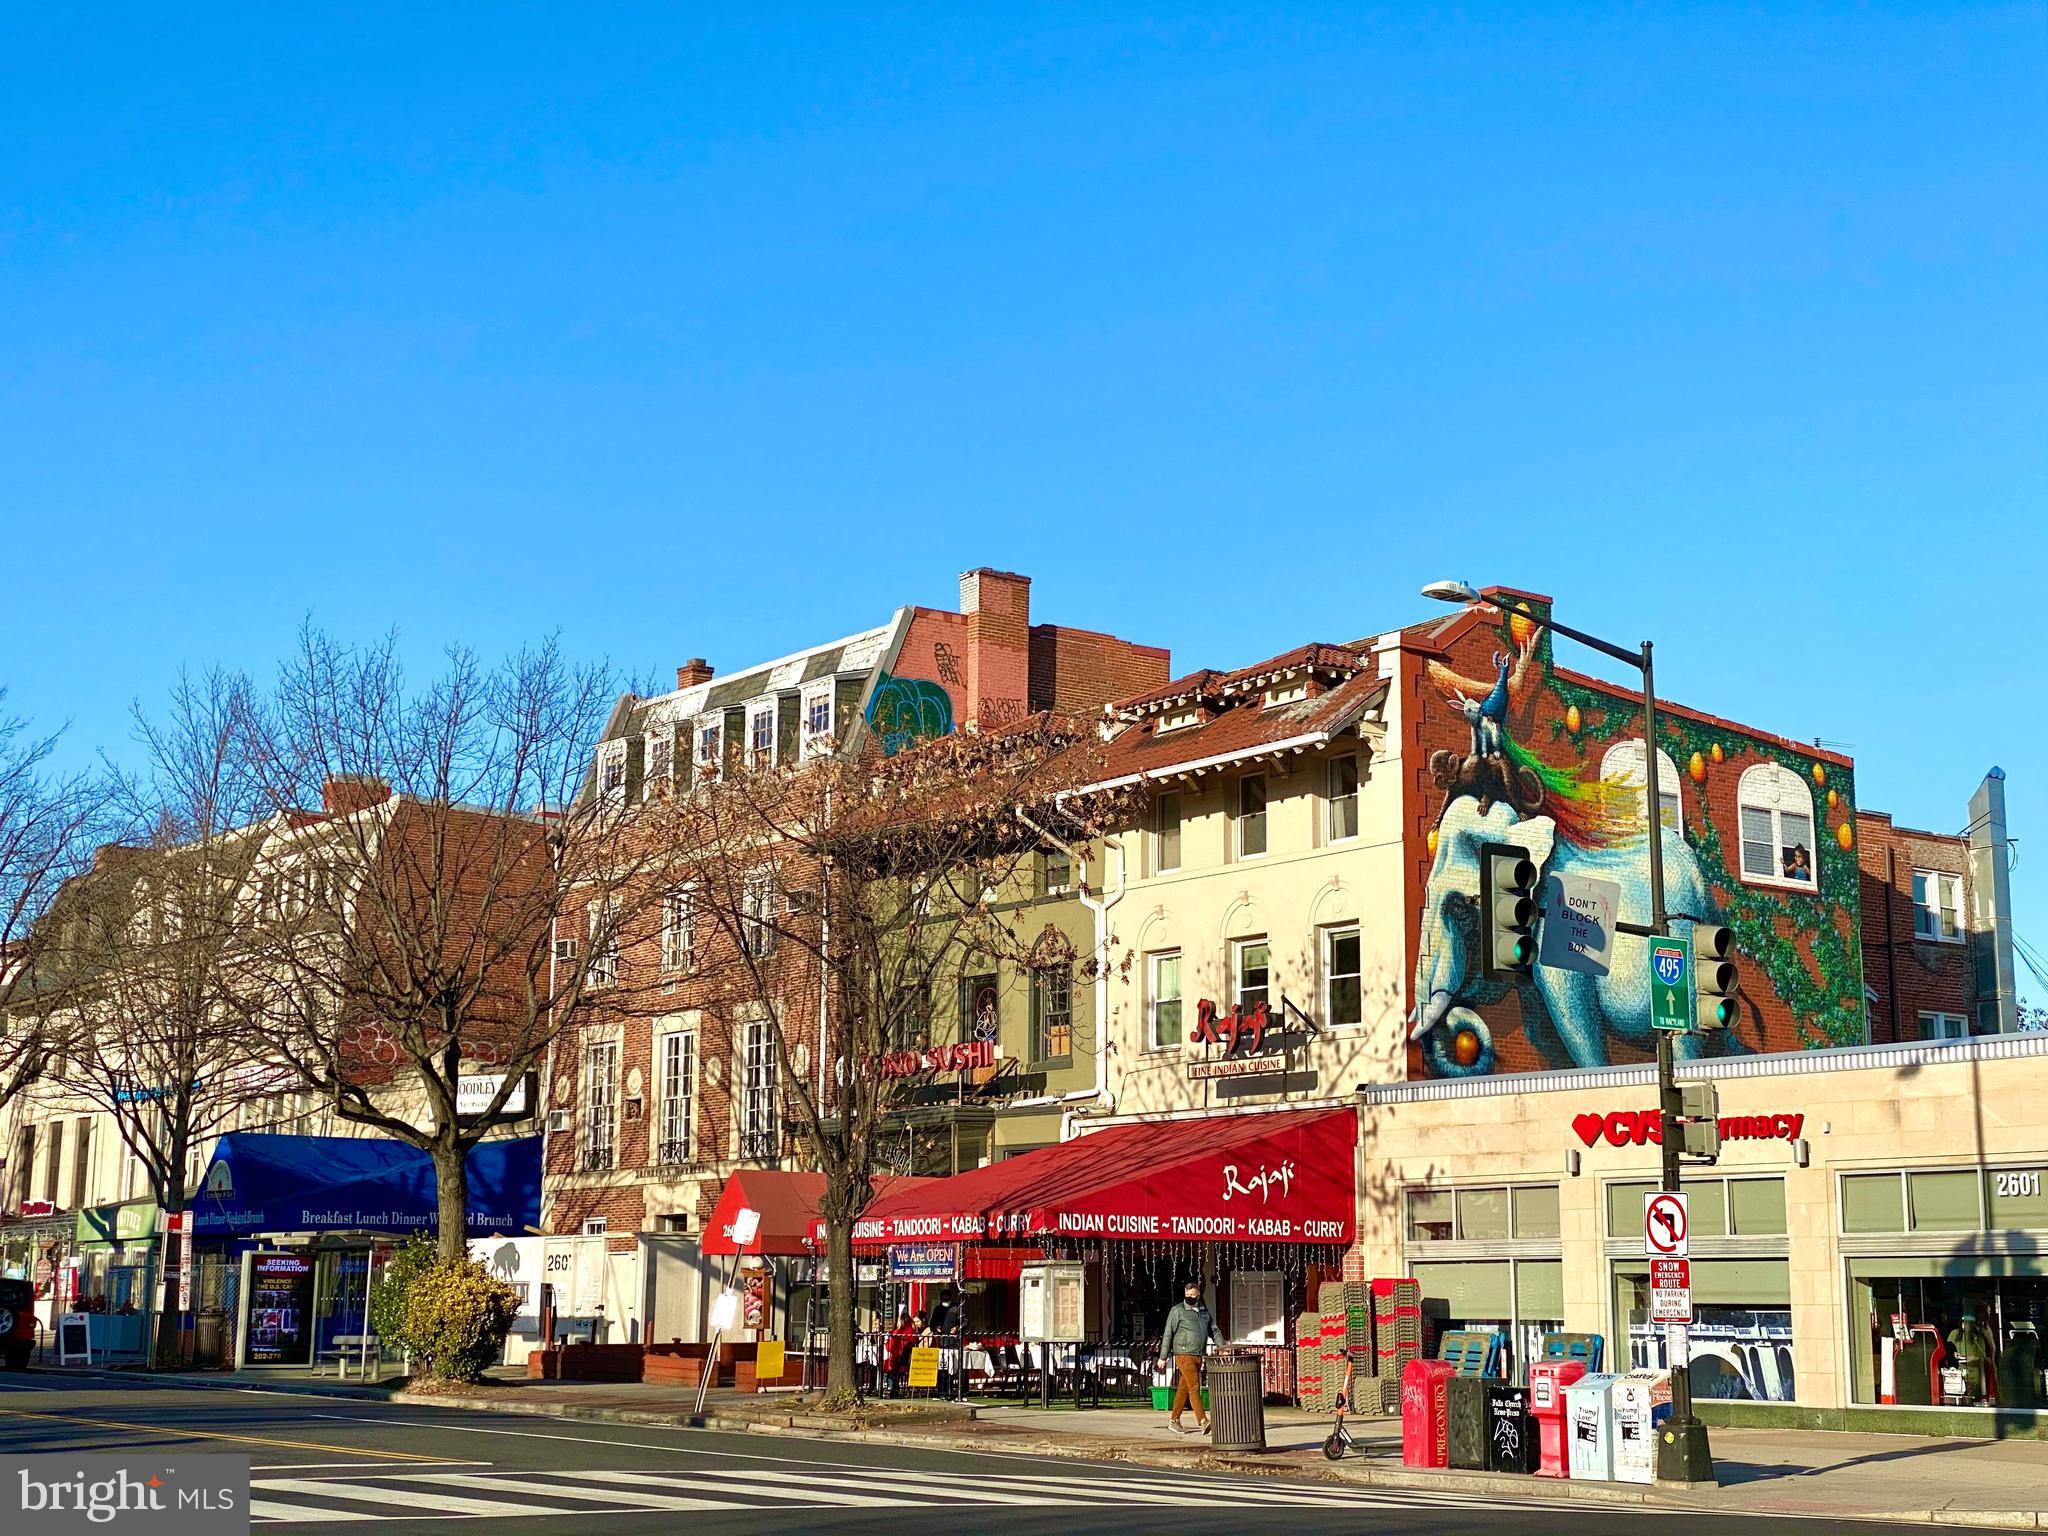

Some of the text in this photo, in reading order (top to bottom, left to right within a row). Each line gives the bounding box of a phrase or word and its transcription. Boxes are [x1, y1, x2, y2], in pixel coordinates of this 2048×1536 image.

[1568, 897, 1598, 911] DON'T
[1561, 910, 1600, 927] BLOCK
[1571, 926, 1589, 938] THE
[1567, 942, 1587, 954] BOX
[1659, 957, 1680, 979] 495
[926, 1040, 996, 1074] SUSHI
[1194, 1059, 1282, 1077] FINE INDIAN CUISINE
[458, 1081, 496, 1096] OODLEY
[1718, 1114, 1804, 1142] rmacy
[1222, 1160, 1295, 1205] Rajaji
[1996, 1172, 2041, 1197] 2601
[302, 1210, 352, 1225] Breakfast
[355, 1211, 388, 1225] Lunch
[392, 1212, 427, 1226] Dinner
[477, 1213, 514, 1227] Brunch
[893, 1217, 942, 1237] TANDOORI
[952, 1216, 986, 1233] KABAB
[996, 1213, 1032, 1233] CURRY
[1059, 1213, 1345, 1238] INDIAN CUISINE TANDOORI KABAB CURRY
[896, 1248, 954, 1263] We Are OPEN!
[256, 1265, 309, 1273] INFORMATION
[894, 1267, 954, 1276] DINE-IN TAKEOUT DELIVERY
[1658, 1261, 1680, 1272] SNOW
[1654, 1271, 1685, 1279] EMERGENCY
[1659, 1279, 1681, 1288] ROUTE
[1655, 1290, 1687, 1298] NO PARKING
[1660, 1299, 1682, 1307] DURING
[1655, 1309, 1688, 1317] EMERGENCY
[1491, 1399, 1522, 1409] Falls Church
[1579, 1407, 1597, 1416] Trump
[1435, 1384, 1446, 1457] PREGONERO
